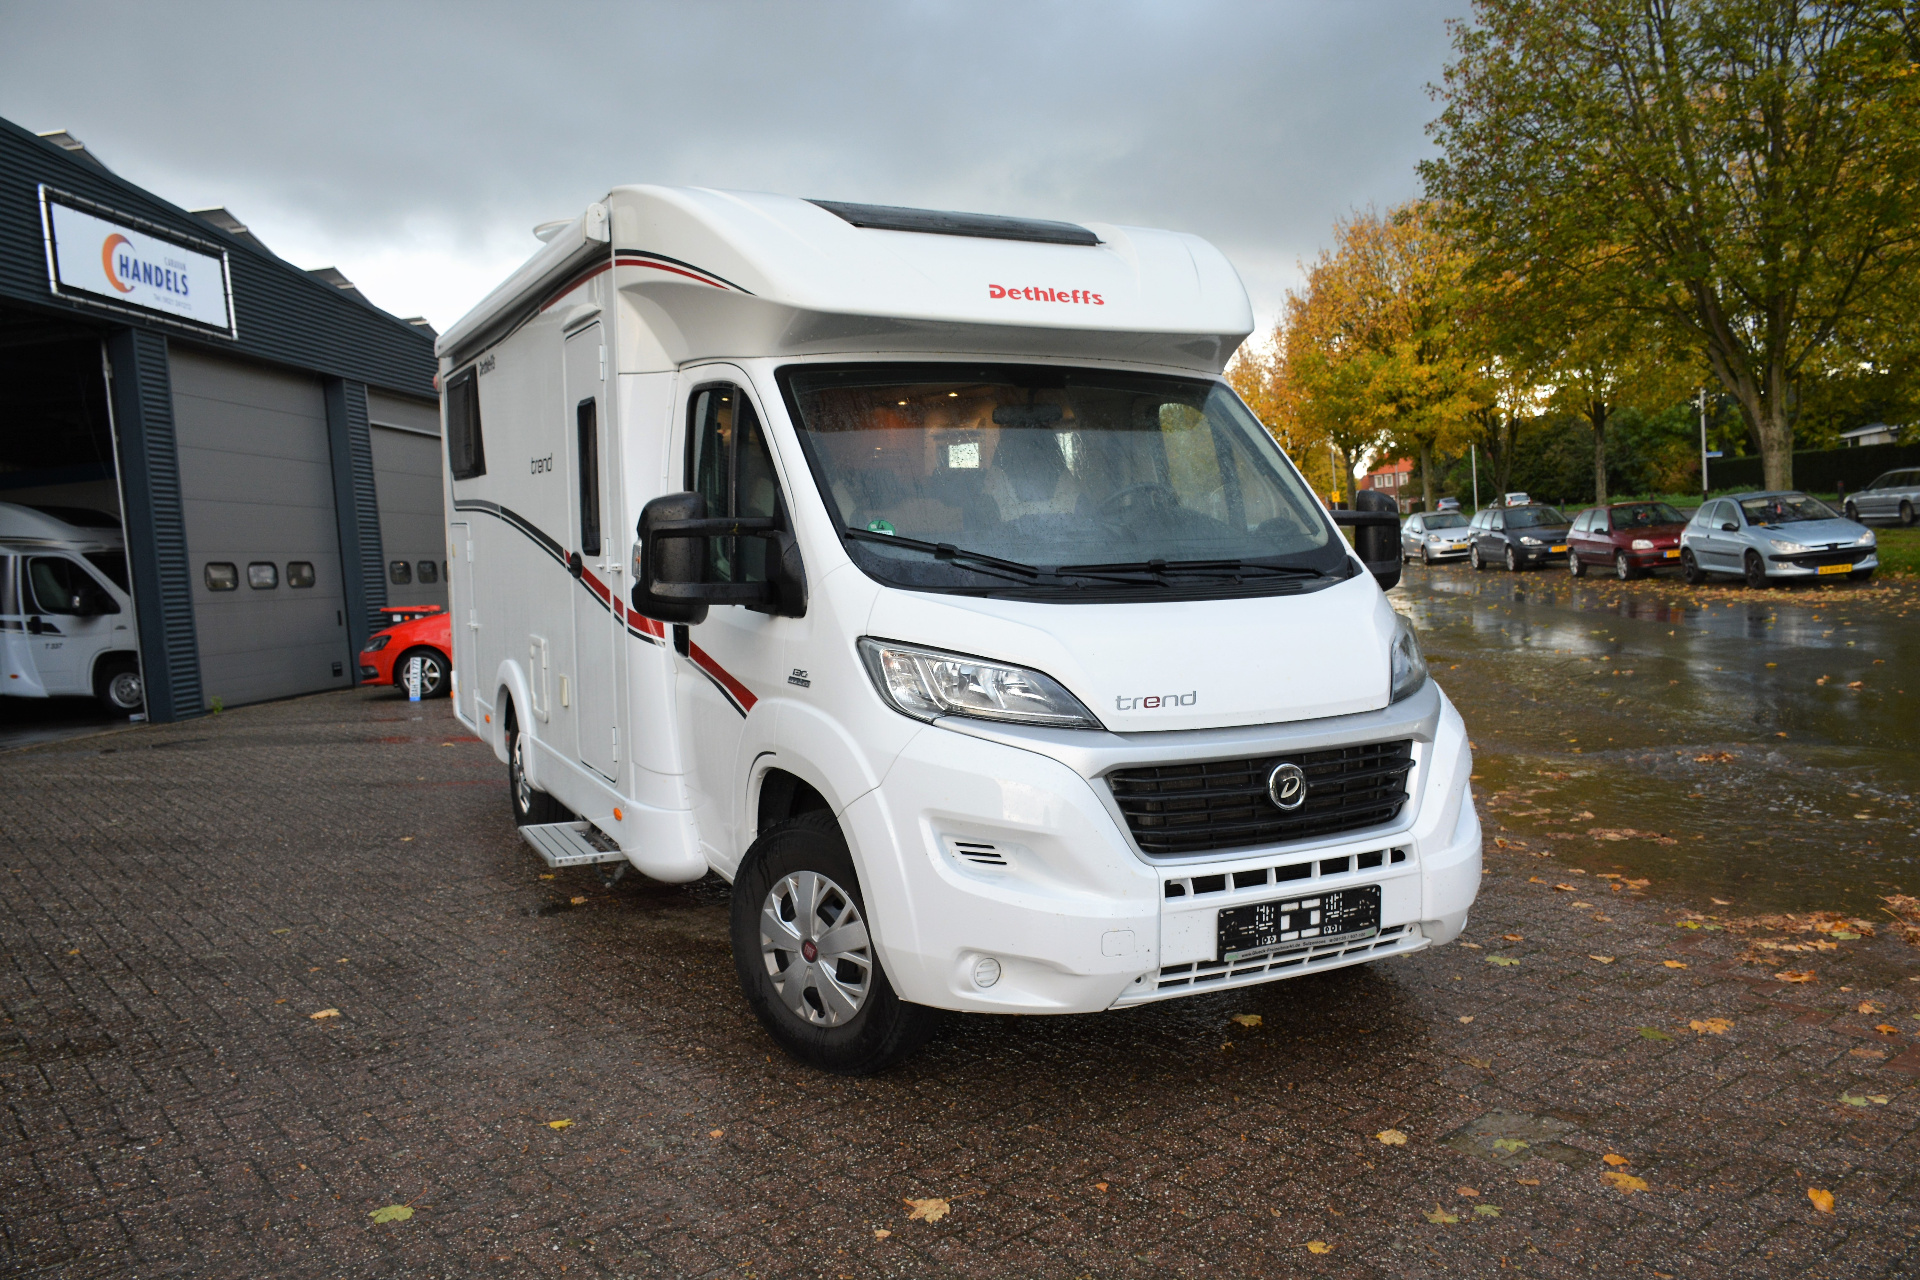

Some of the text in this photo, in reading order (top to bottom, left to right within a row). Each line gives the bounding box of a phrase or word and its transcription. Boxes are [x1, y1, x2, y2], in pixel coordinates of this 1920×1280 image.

[987, 283, 1105, 306] Dethleffs
[530, 452, 553, 475] trend
[1115, 690, 1197, 711] trend
